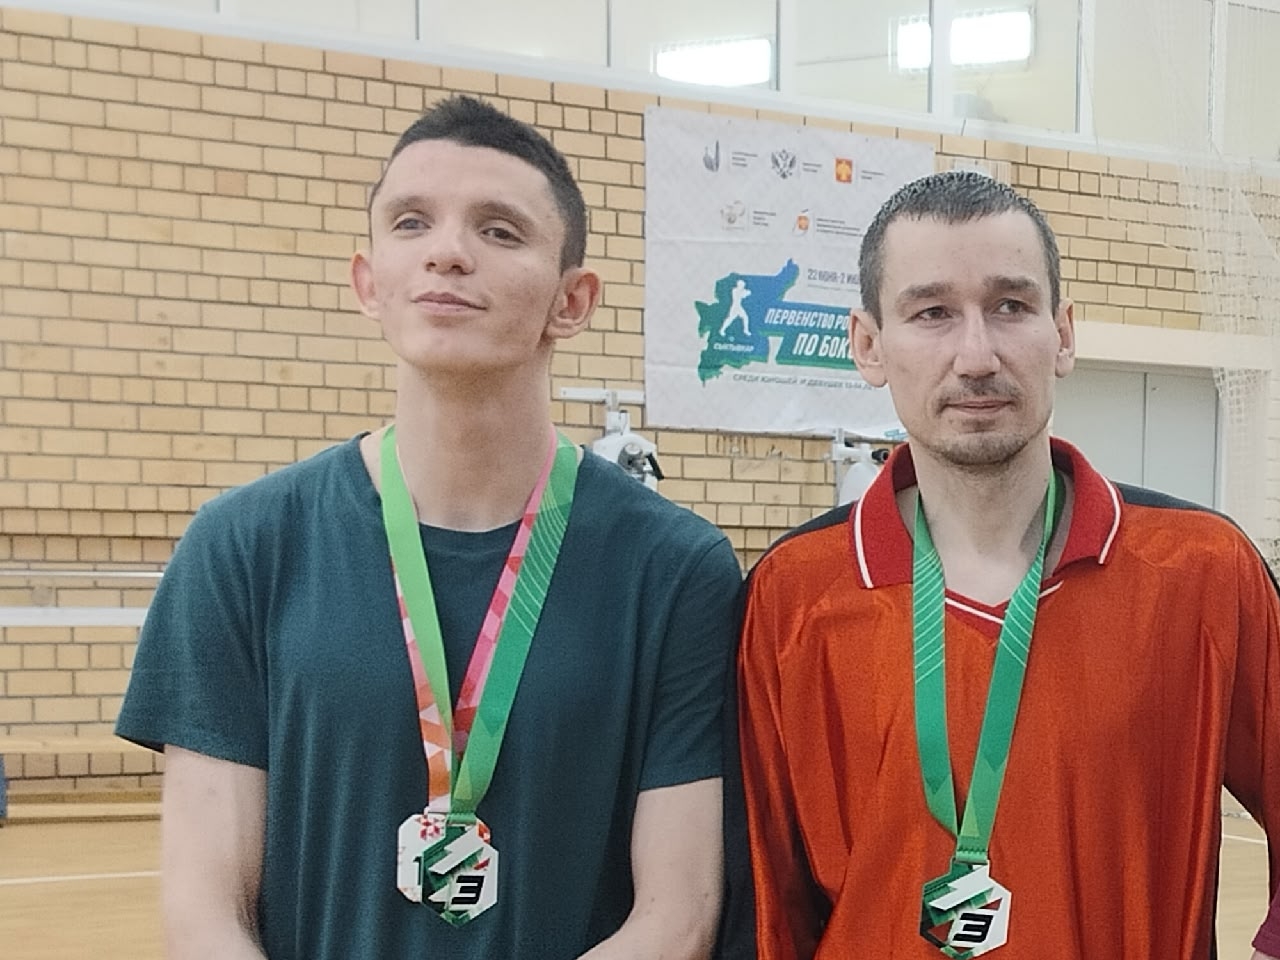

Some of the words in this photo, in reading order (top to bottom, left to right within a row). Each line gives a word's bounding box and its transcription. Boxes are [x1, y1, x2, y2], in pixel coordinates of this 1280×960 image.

[764, 308, 835, 330] ПЕРВЕНСТВО
[792, 333, 820, 356] ПО
[451, 875, 485, 905] 3
[952, 912, 994, 943] 3
